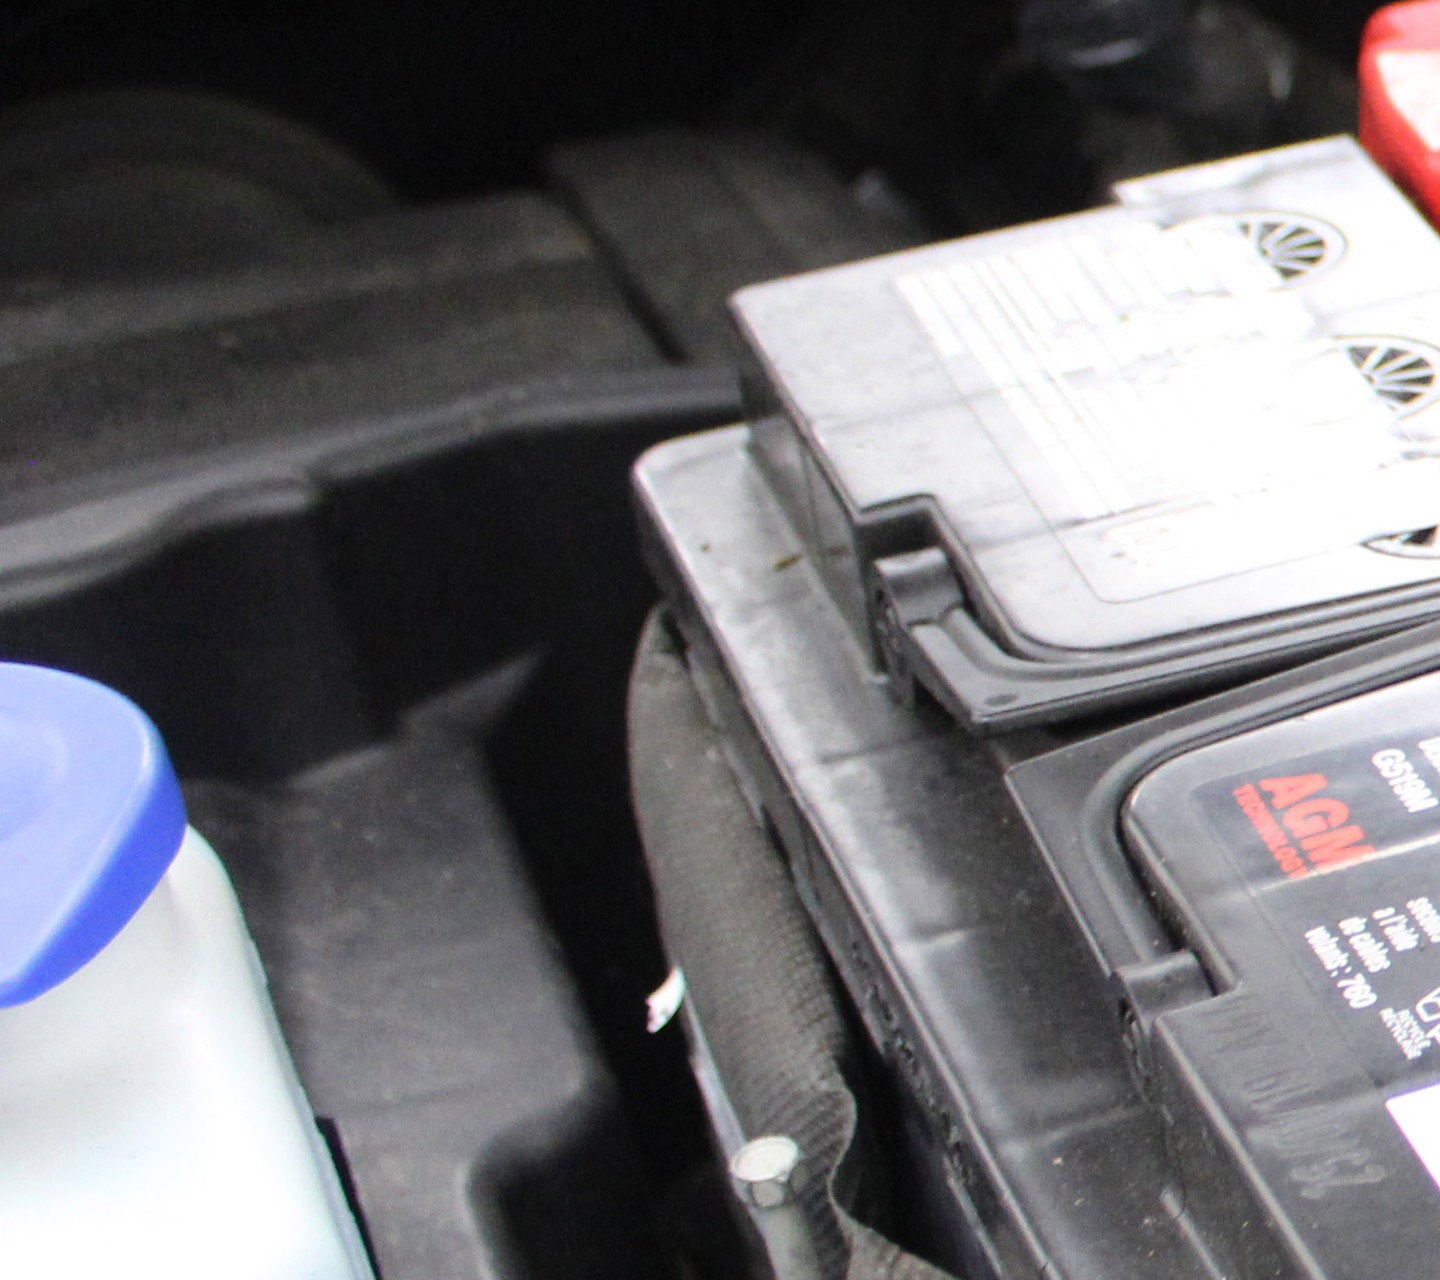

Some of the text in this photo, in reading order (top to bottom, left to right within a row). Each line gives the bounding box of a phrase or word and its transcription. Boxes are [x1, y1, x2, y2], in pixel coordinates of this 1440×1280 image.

[1372, 748, 1439, 813] G519M
[1232, 783, 1309, 878] TECHNOLOGY
[1258, 773, 1376, 869] AGM
[1337, 972, 1377, 1009] 760
